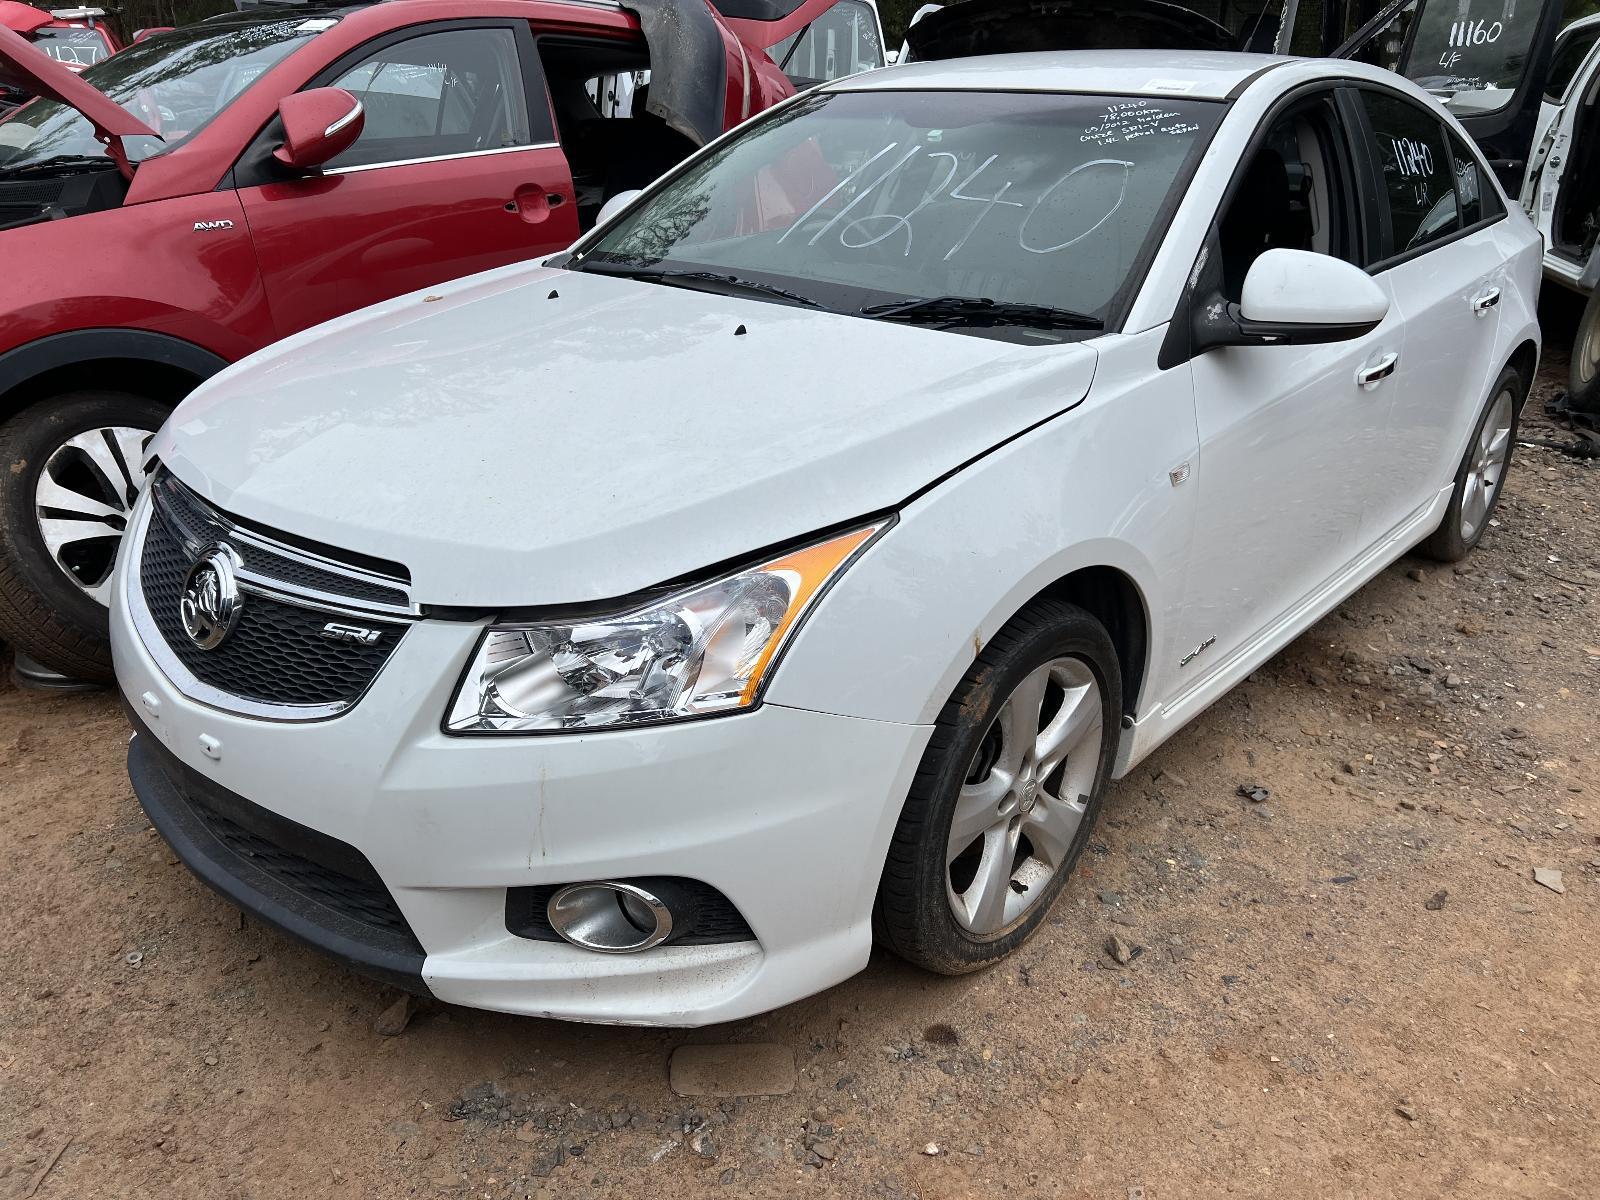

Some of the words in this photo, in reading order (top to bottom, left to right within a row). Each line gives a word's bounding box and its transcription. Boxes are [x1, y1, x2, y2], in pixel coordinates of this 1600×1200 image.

[1448, 18, 1503, 48] 11160
[1438, 51, 1462, 68] L/F
[1107, 100, 1147, 113] 11240
[1391, 137, 1434, 178] 11240
[777, 142, 1135, 261] 11240
[193, 219, 233, 231] AWD
